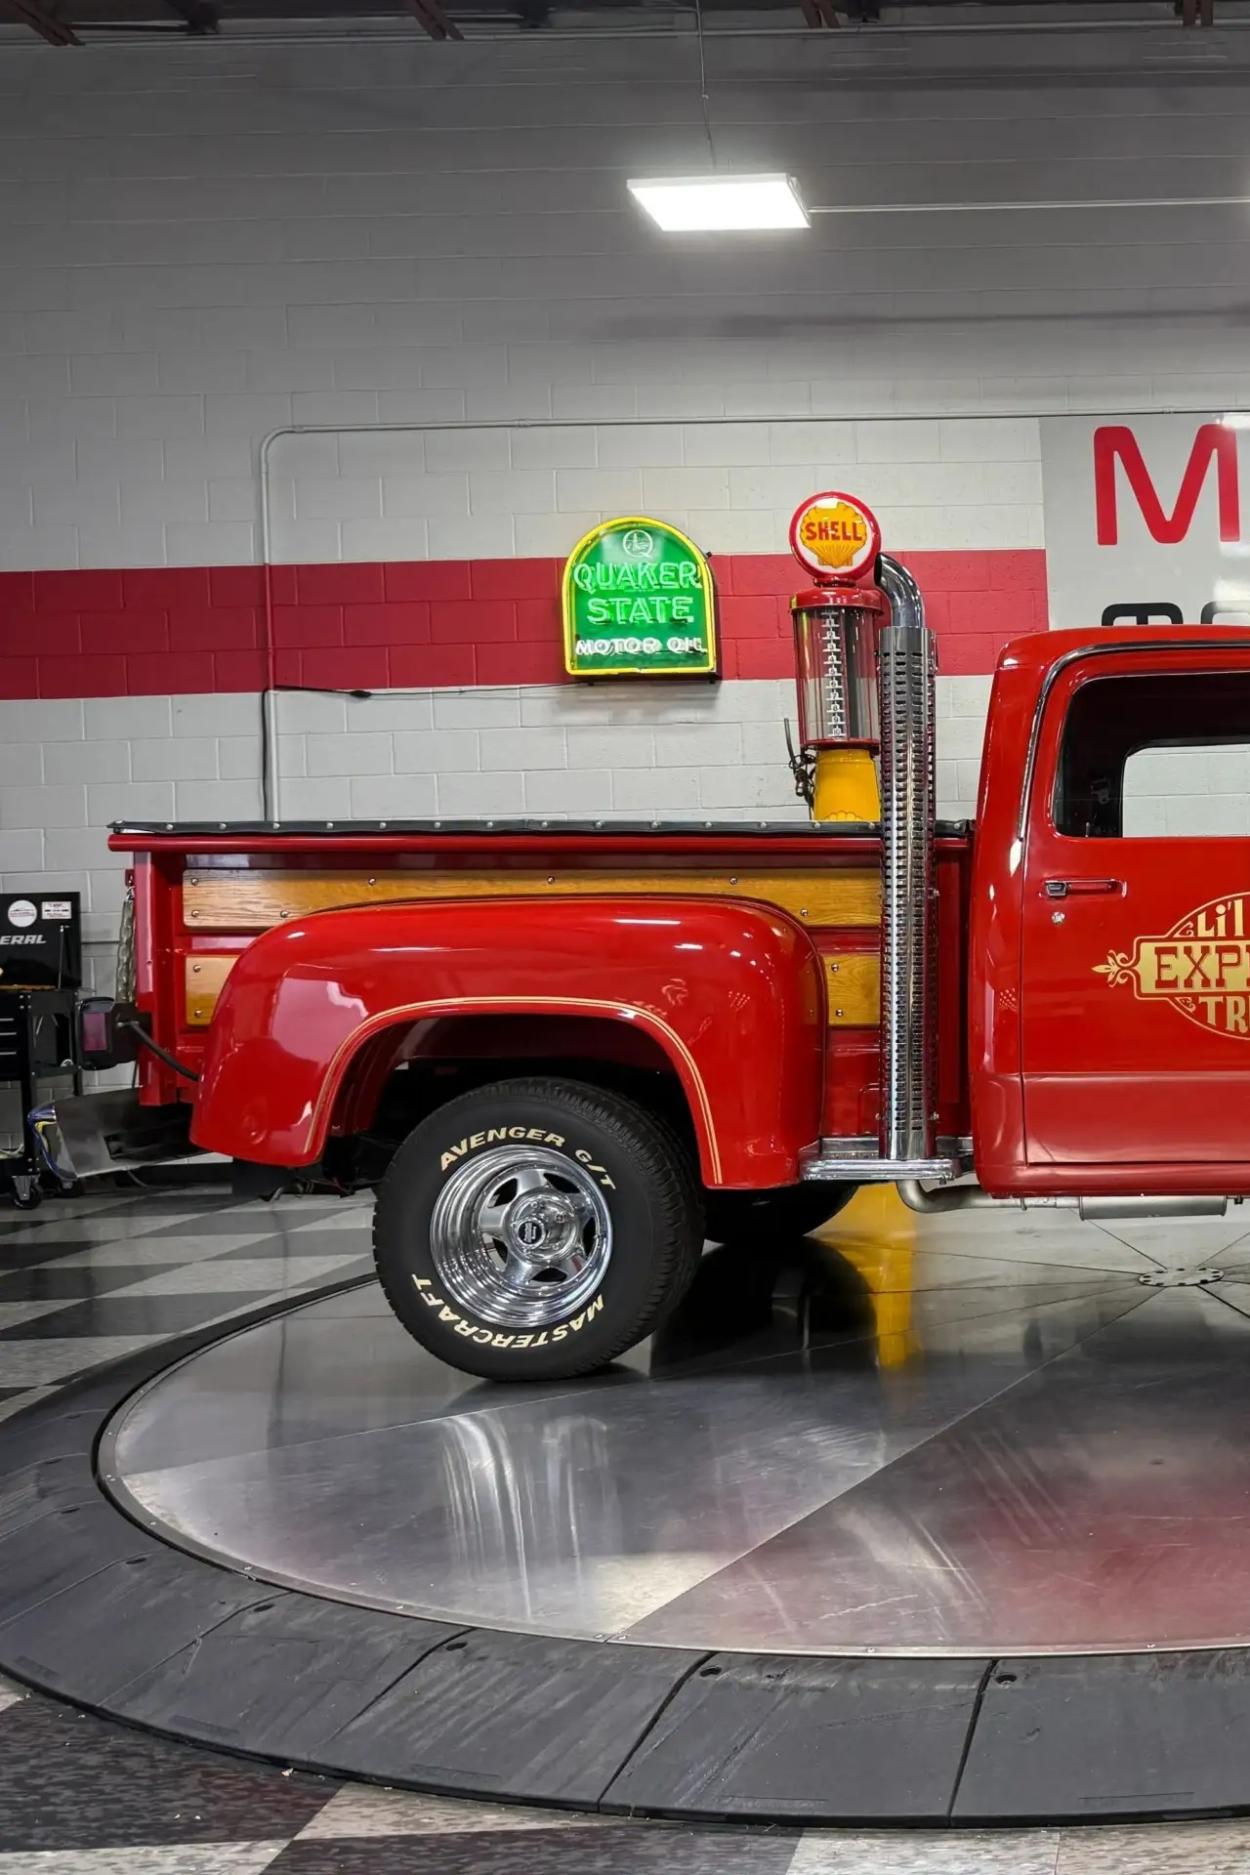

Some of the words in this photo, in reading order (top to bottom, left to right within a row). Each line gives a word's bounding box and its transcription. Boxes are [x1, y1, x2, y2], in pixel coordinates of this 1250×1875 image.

[804, 520, 863, 542] SHELL
[573, 561, 703, 594] QUAKER
[586, 596, 695, 624] STATE
[576, 637, 664, 655] MOTOR
[666, 637, 707, 654] OIL
[0, 934, 47, 945] ERAL
[440, 1126, 566, 1171] AVENGER
[575, 1149, 617, 1190] G/T
[411, 1273, 606, 1349] MASTERCRAFT
